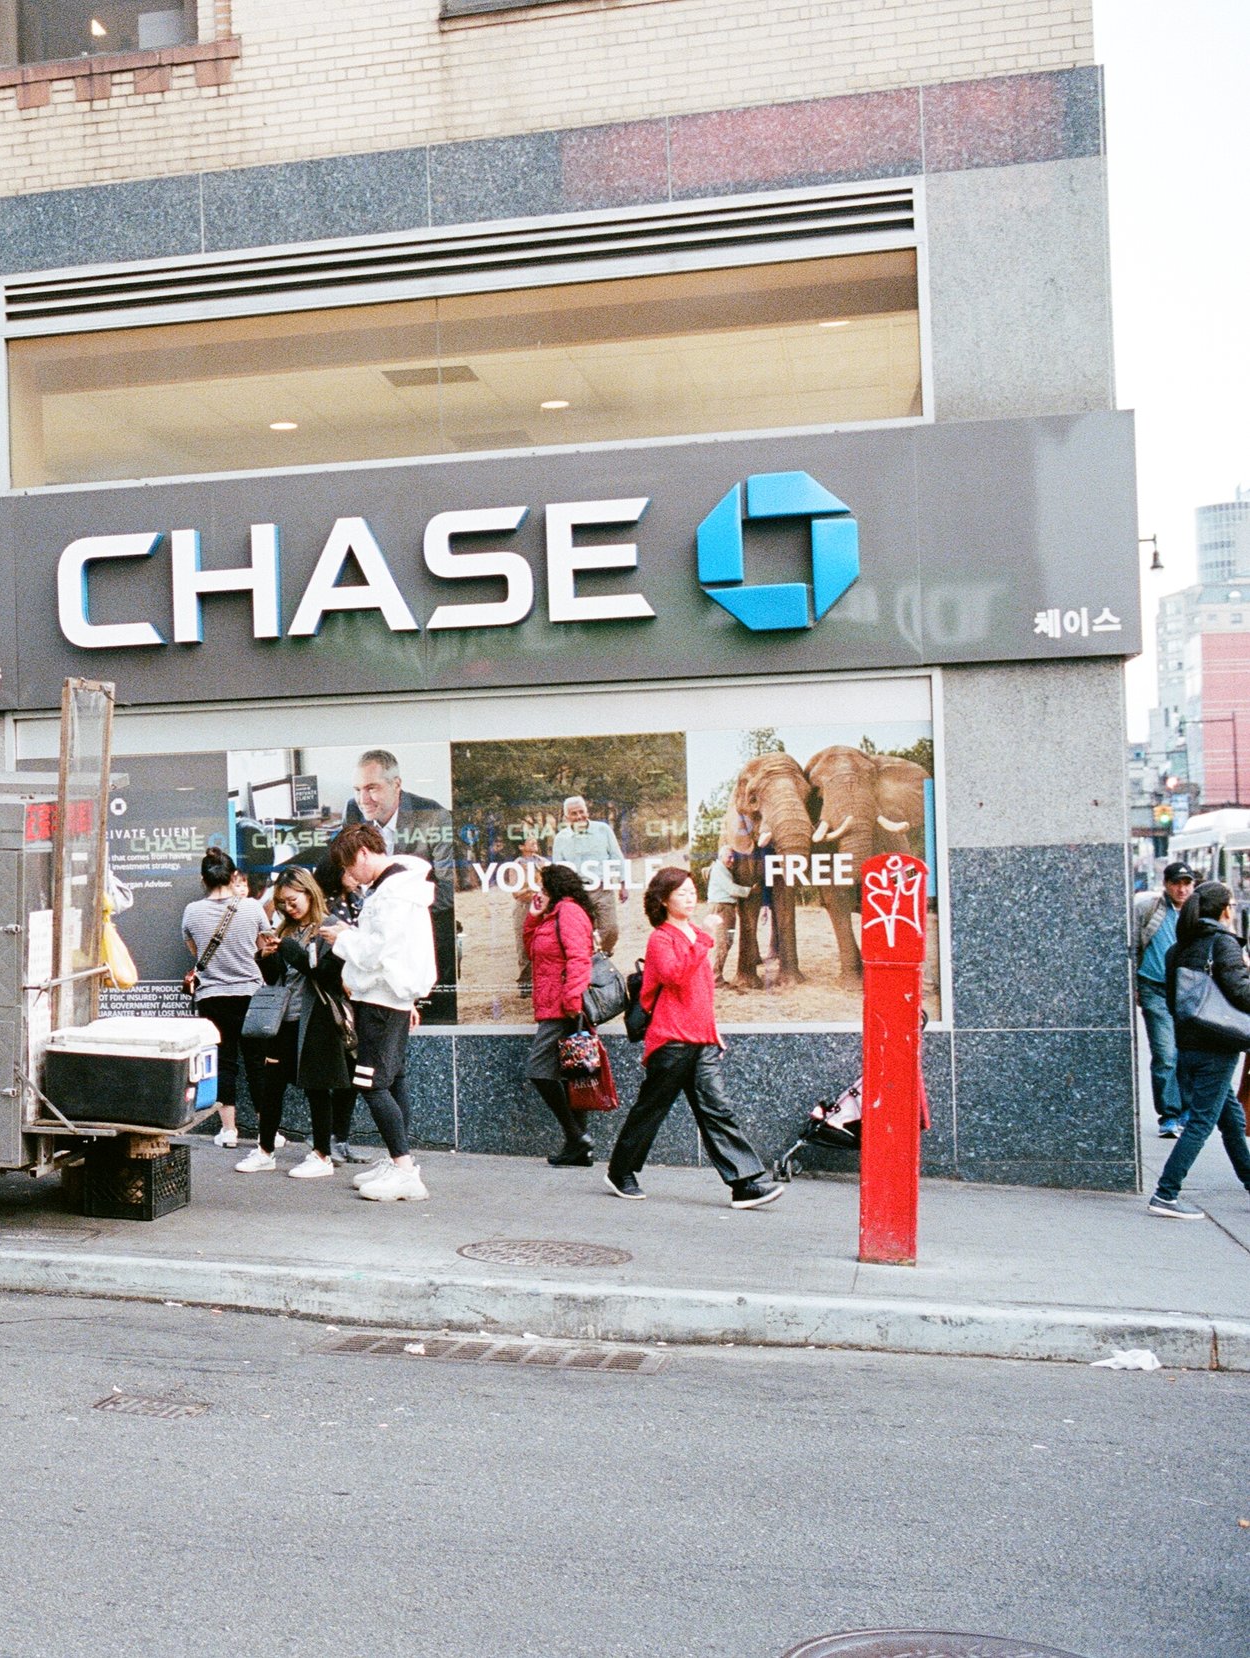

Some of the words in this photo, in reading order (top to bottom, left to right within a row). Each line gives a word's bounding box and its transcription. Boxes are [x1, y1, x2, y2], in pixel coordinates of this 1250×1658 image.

[57, 498, 656, 648] CHASE
[1034, 607, 1122, 638] 체이스
[153, 827, 197, 838] CLIENT
[252, 830, 328, 849] CHASE
[393, 826, 453, 845] HASE
[130, 835, 205, 852] CHASE
[472, 858, 663, 894] YOUSELF
[764, 853, 854, 887] FREE
[110, 1002, 160, 1010] GOVERNMENT
[161, 1001, 190, 1009] AGENCY
[126, 993, 157, 1001] INSURED
[163, 993, 179, 1001] NOT
[158, 1009, 175, 1017] LOSE
